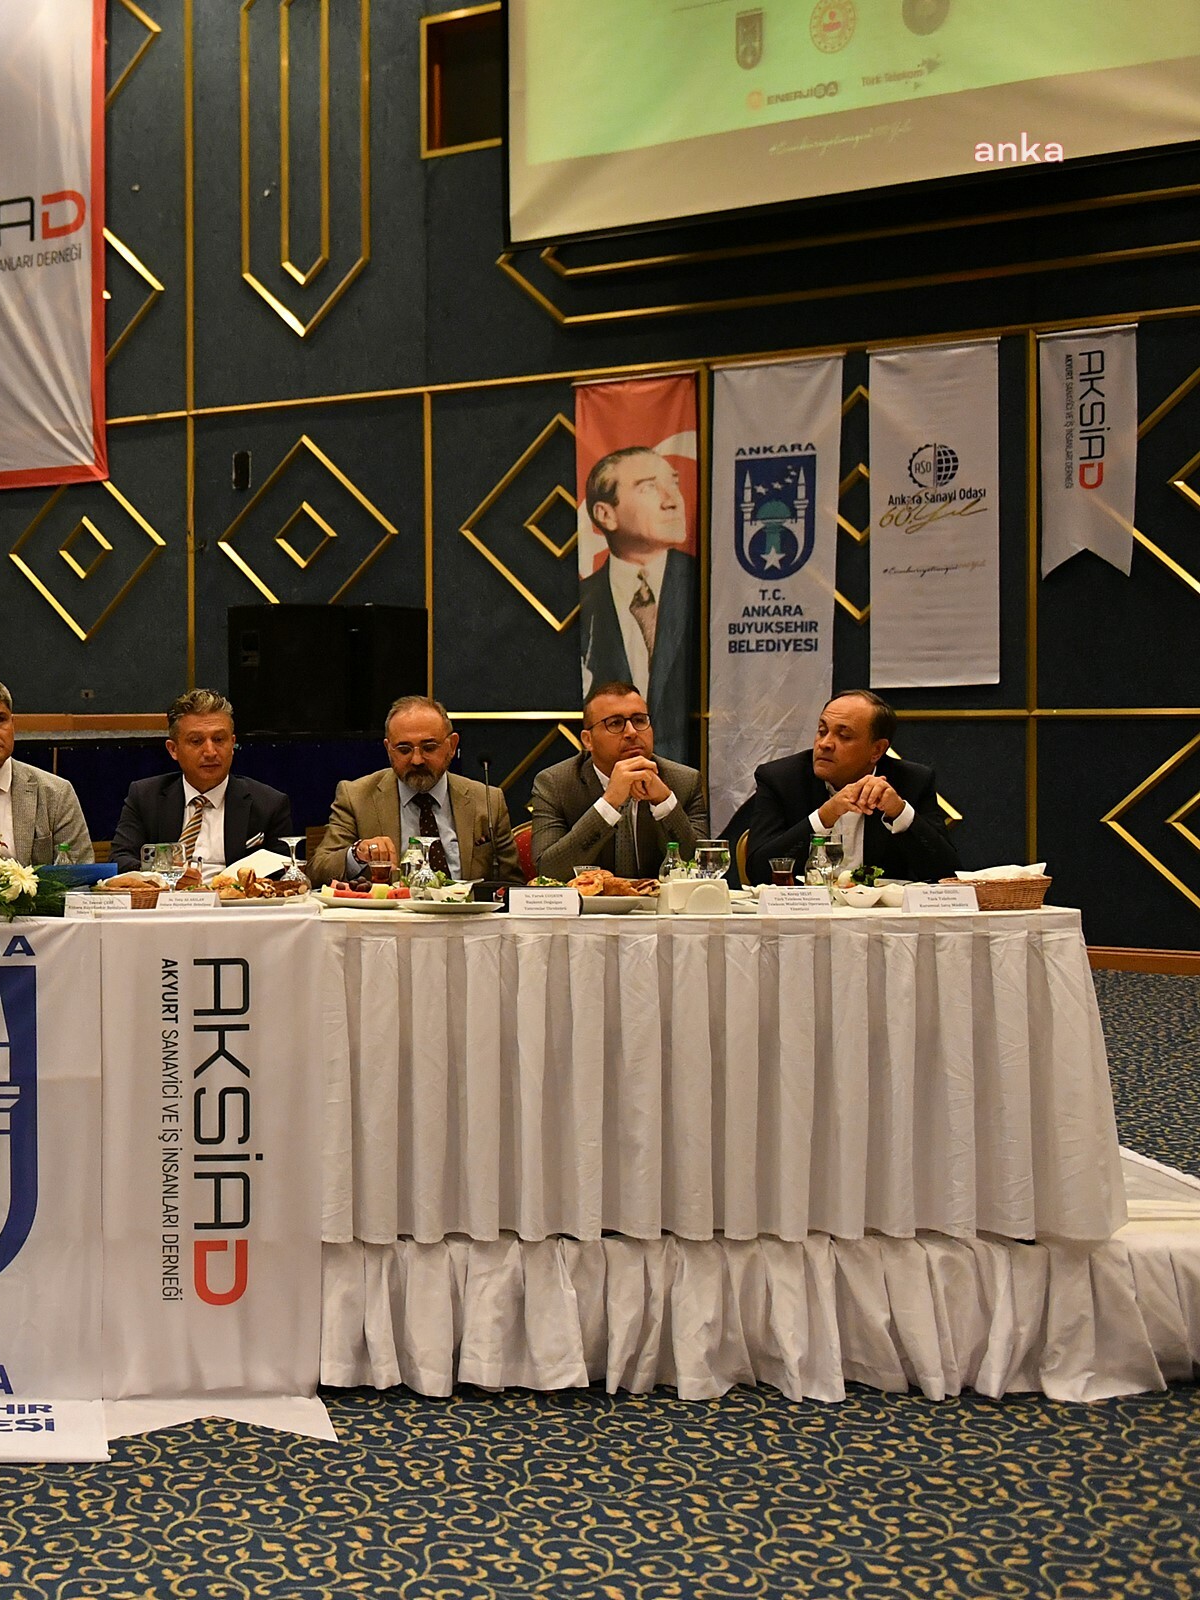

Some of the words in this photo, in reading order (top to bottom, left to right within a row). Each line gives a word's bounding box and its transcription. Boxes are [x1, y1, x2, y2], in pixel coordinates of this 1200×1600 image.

[36, 243, 82, 268] DERNEĞİ
[1078, 349, 1111, 490] AKSİAD
[735, 442, 817, 457] ANKARA
[914, 460, 932, 475] ASO
[888, 494, 922, 507] Ankara
[924, 490, 957, 505] Sanayi
[959, 487, 986, 501] Odası
[759, 588, 786, 601] T.C.
[742, 604, 803, 618] ANKARA
[161, 957, 179, 1025] AKYURT
[161, 1029, 183, 1099] SANAYİCİ
[161, 1104, 179, 1124] VE
[158, 1129, 183, 1143] İŞ
[193, 957, 264, 1307] AKSİAD
[161, 1147, 183, 1229] İNSANLARI
[161, 1233, 183, 1301] DERNEĞİ
